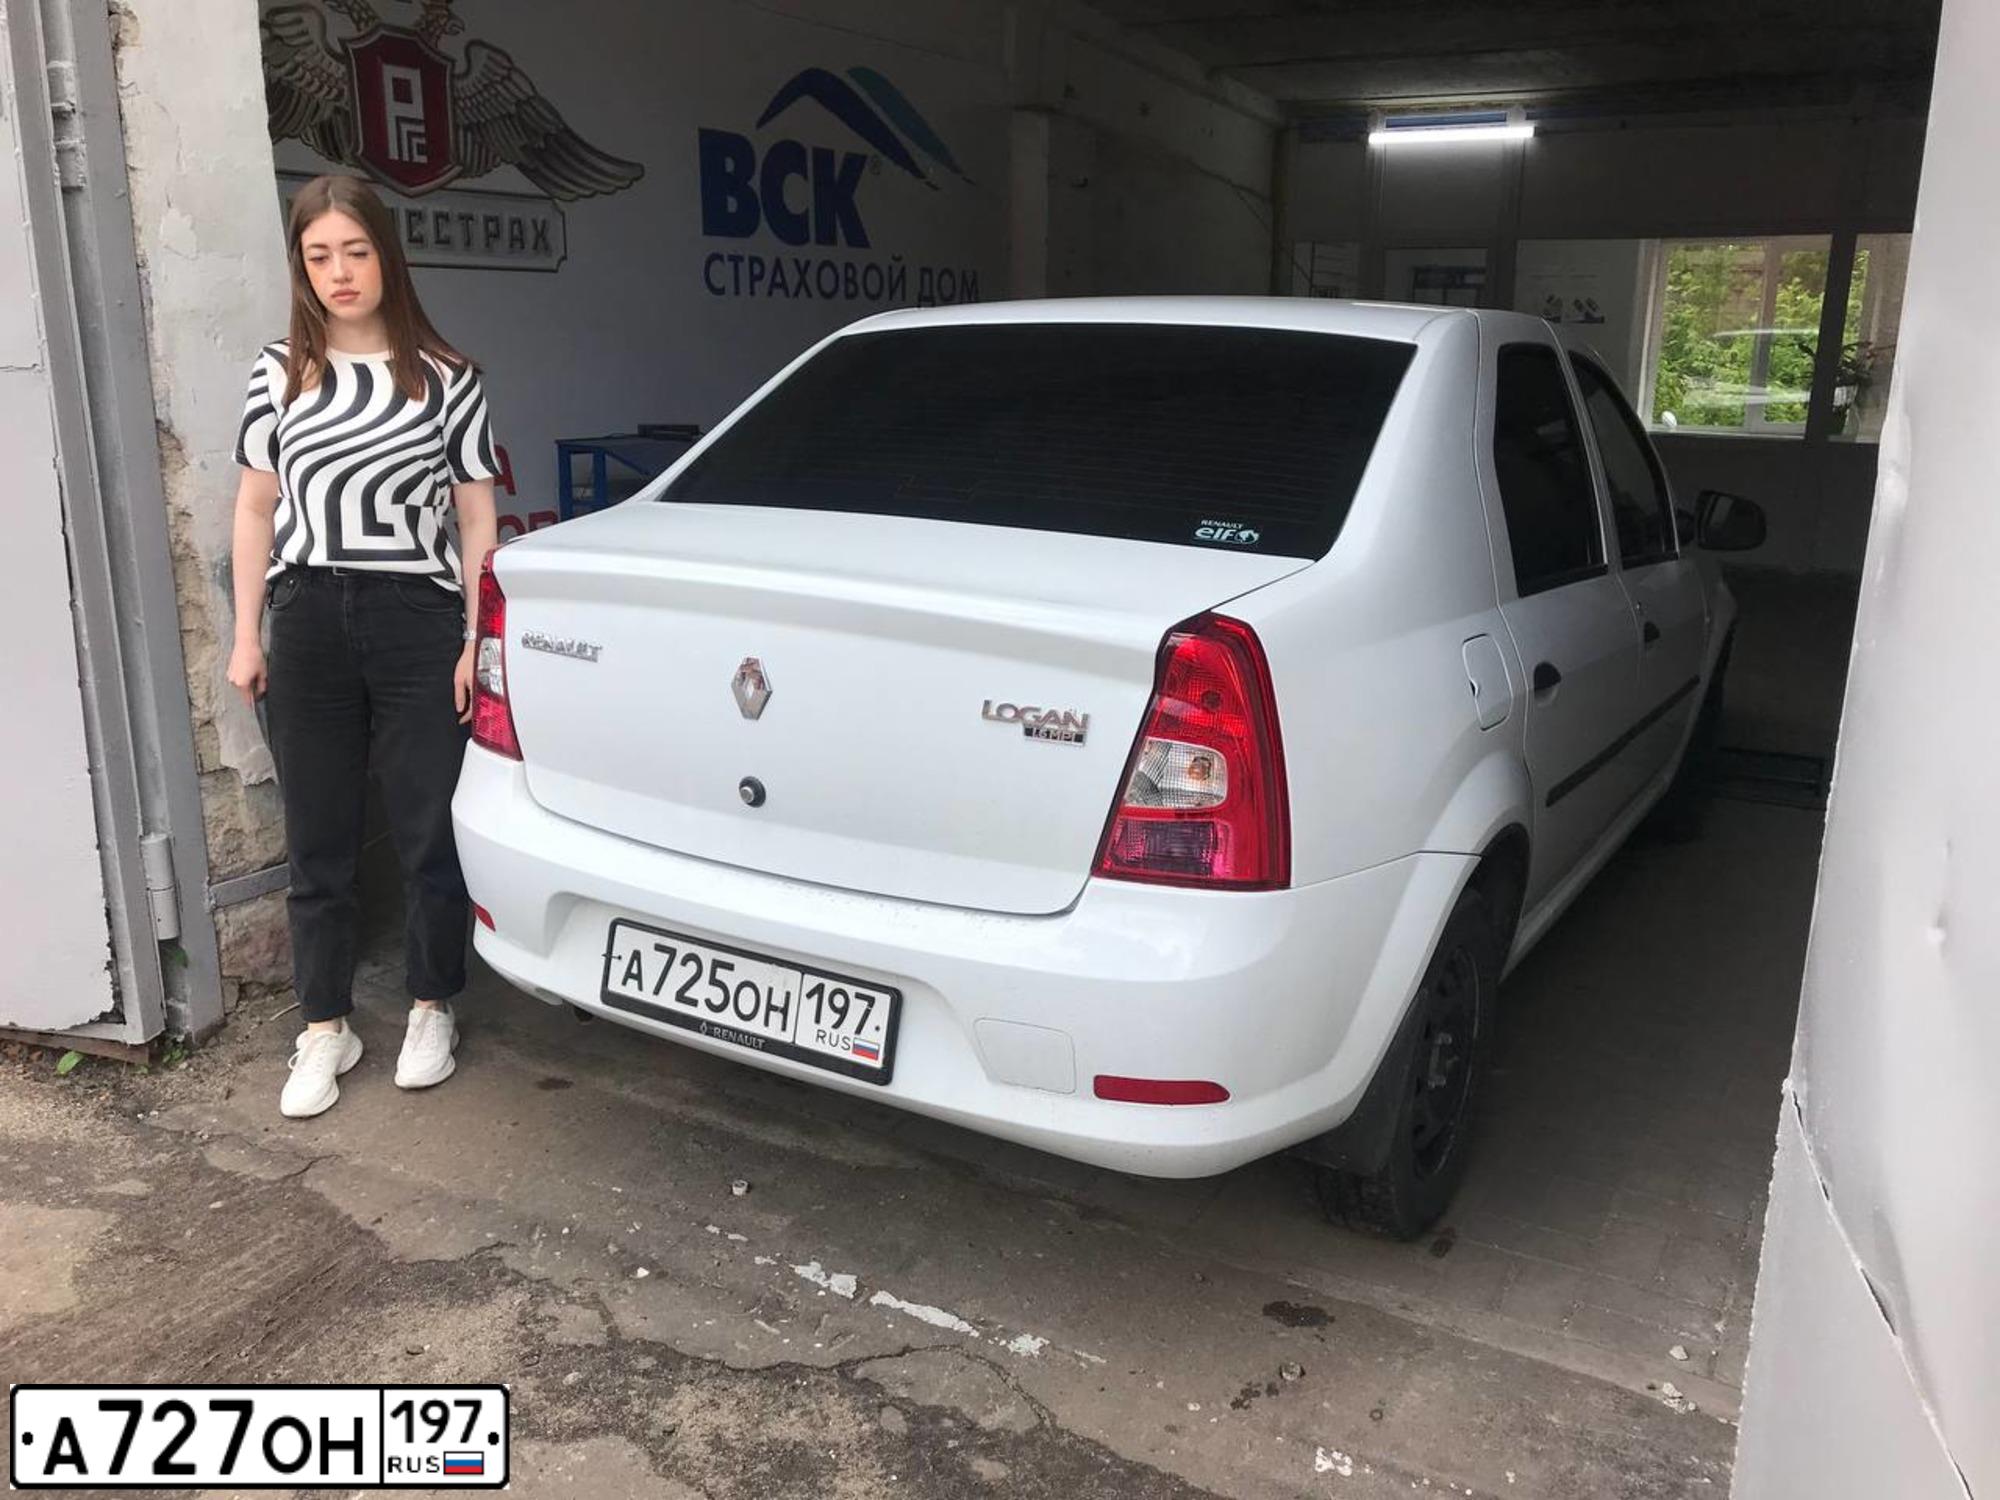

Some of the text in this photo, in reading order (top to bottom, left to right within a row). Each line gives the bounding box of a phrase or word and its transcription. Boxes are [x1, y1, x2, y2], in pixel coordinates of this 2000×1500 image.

[697, 126, 873, 249] ВСК
[390, 206, 552, 256] ССТРАХ
[703, 252, 981, 308] СТРАХОВОЙ ДОМ
[1200, 519, 1244, 529] RENAULT
[981, 699, 1091, 730] LOGAN
[805, 982, 876, 1035] 197
[711, 1026, 766, 1050] RENAULT
[815, 1028, 851, 1051] RUS
